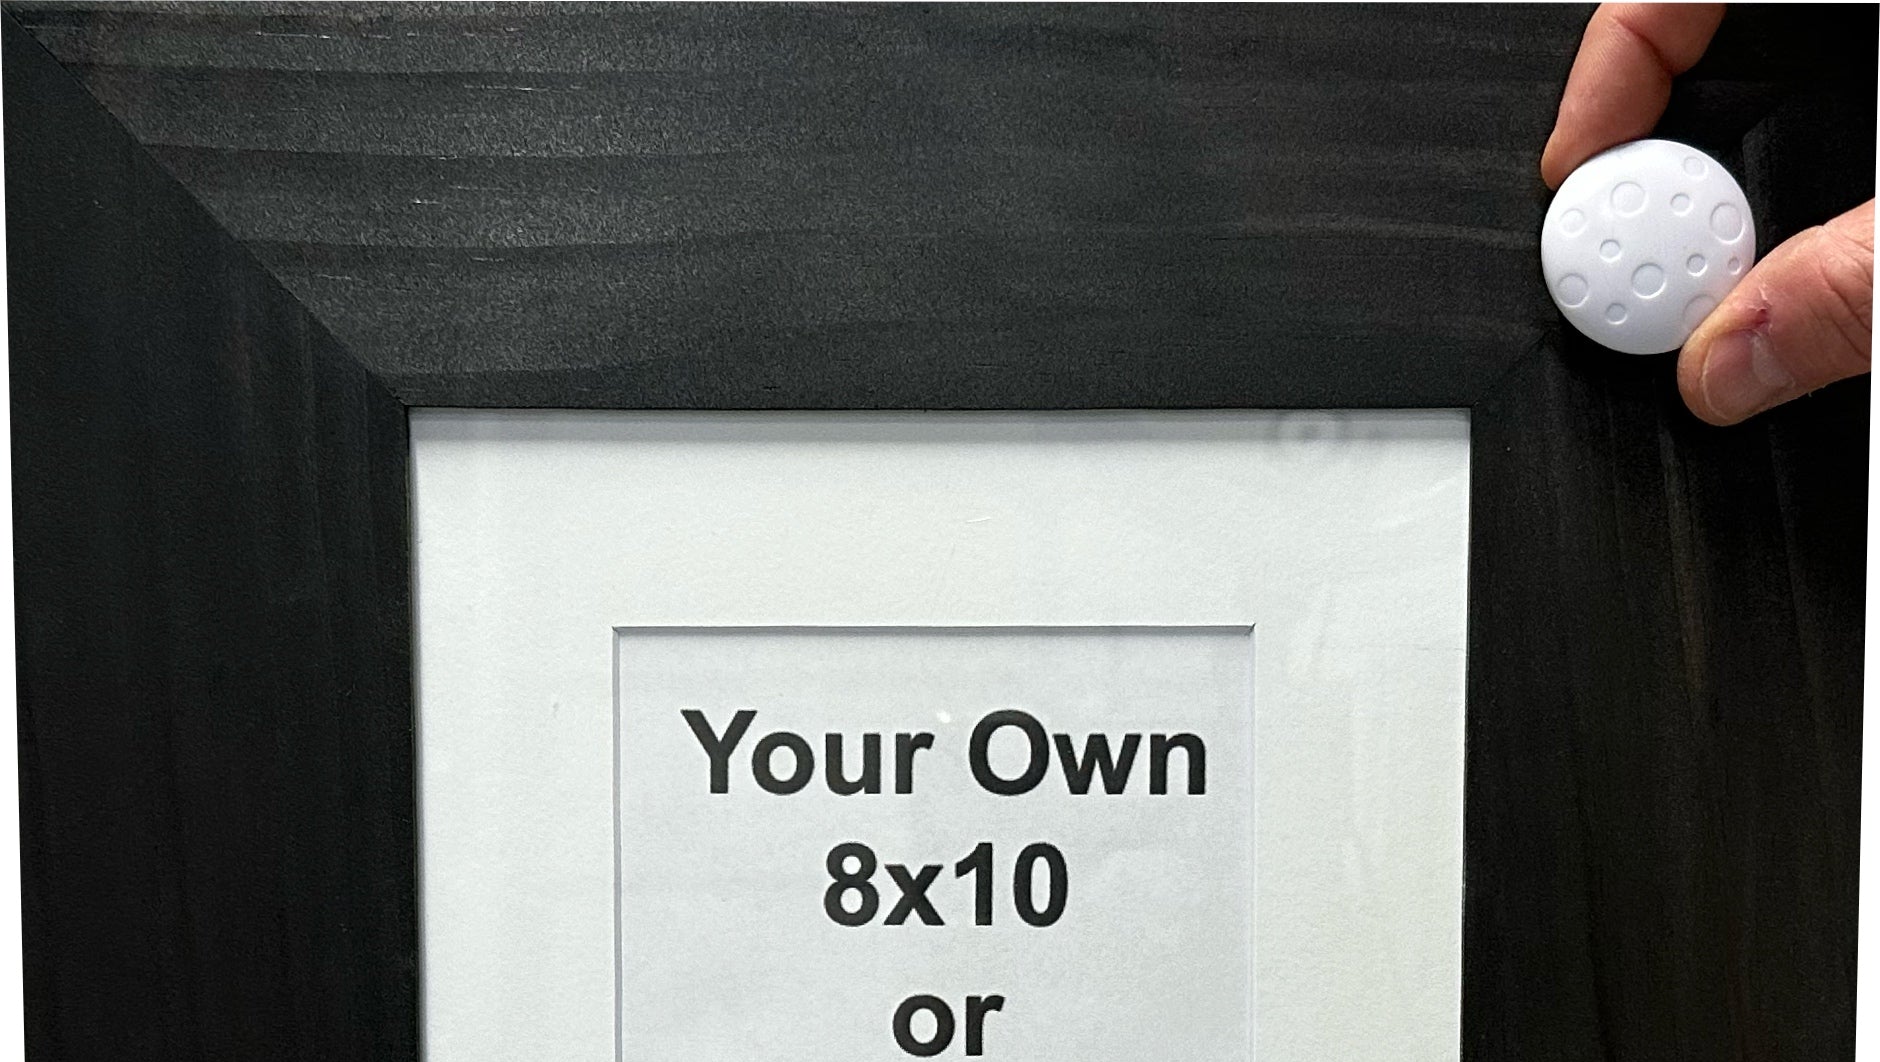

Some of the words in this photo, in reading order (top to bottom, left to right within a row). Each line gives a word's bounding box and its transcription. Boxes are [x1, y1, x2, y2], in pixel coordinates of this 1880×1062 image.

[681, 710, 935, 797] Your
[968, 709, 1206, 797] Own
[824, 842, 1069, 928] 8x10
[892, 994, 1005, 1058] or
